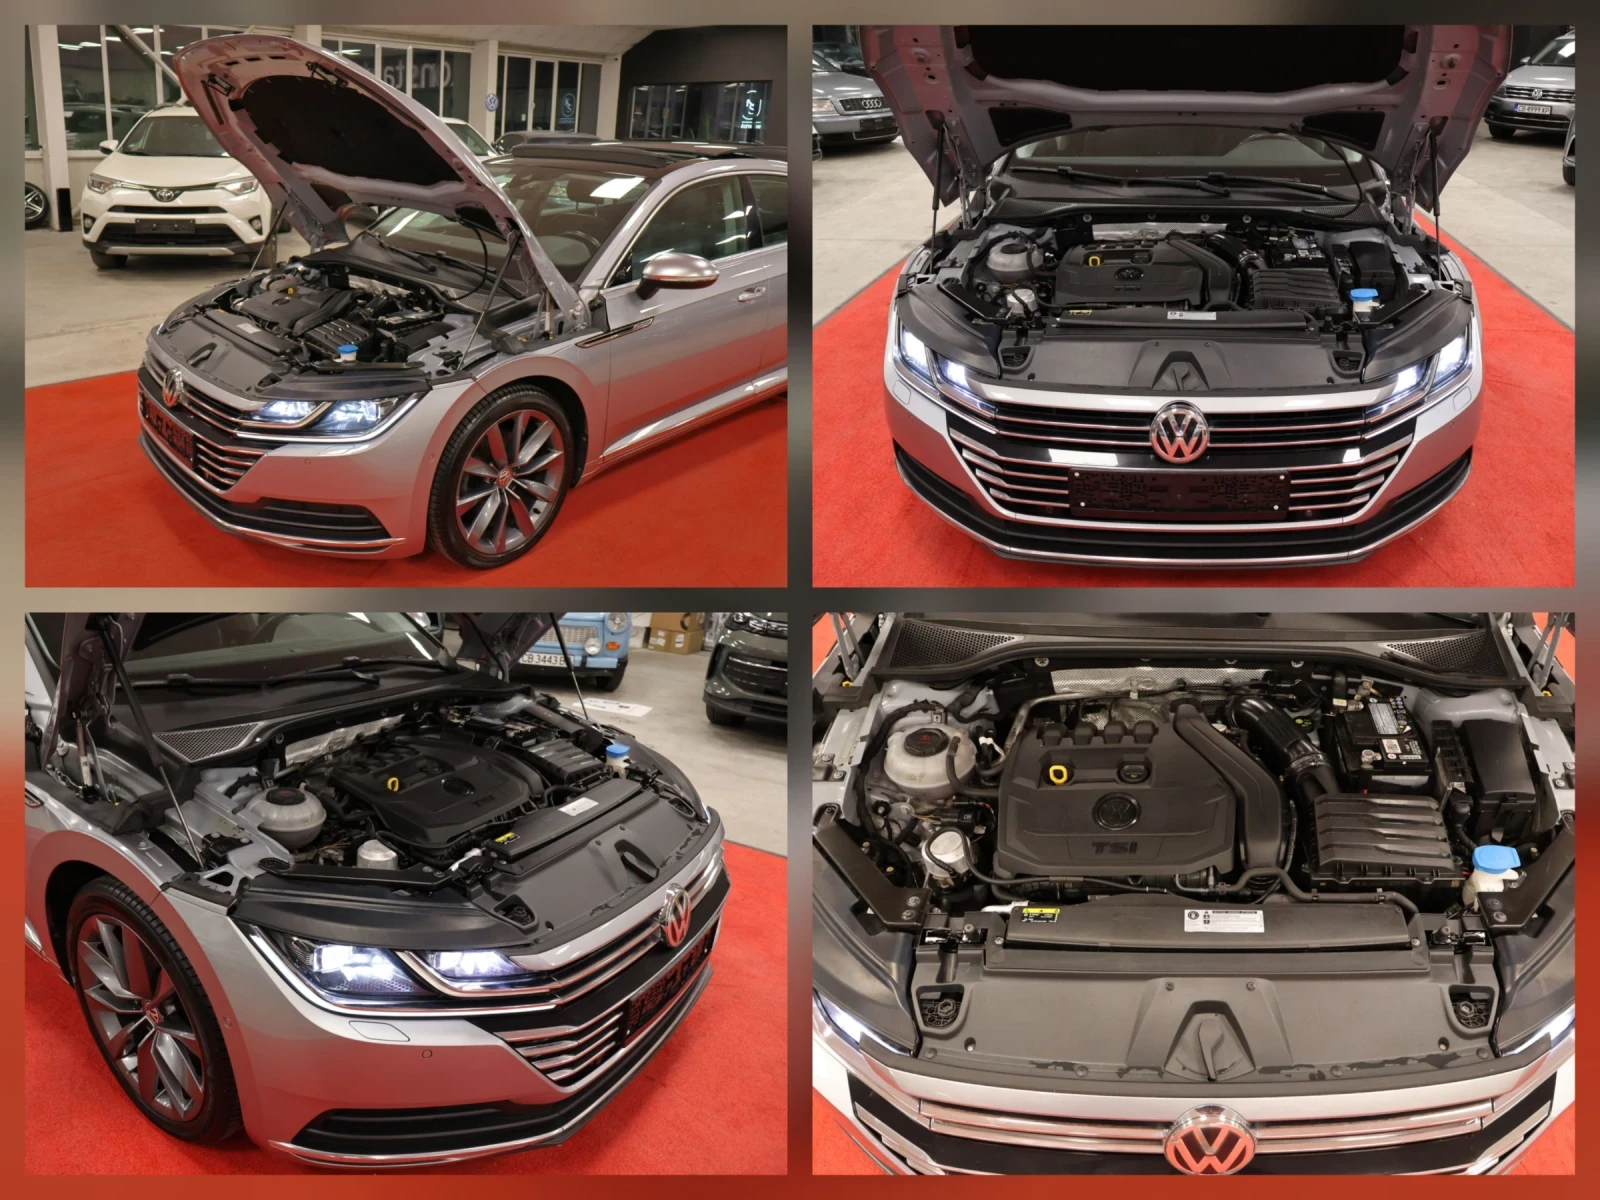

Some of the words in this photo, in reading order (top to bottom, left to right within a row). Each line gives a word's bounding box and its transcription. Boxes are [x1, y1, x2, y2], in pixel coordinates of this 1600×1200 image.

[1527, 105, 1541, 113] 4999
[521, 654, 534, 663] CB
[535, 655, 558, 665] 3443
[1091, 841, 1139, 855] TSI
